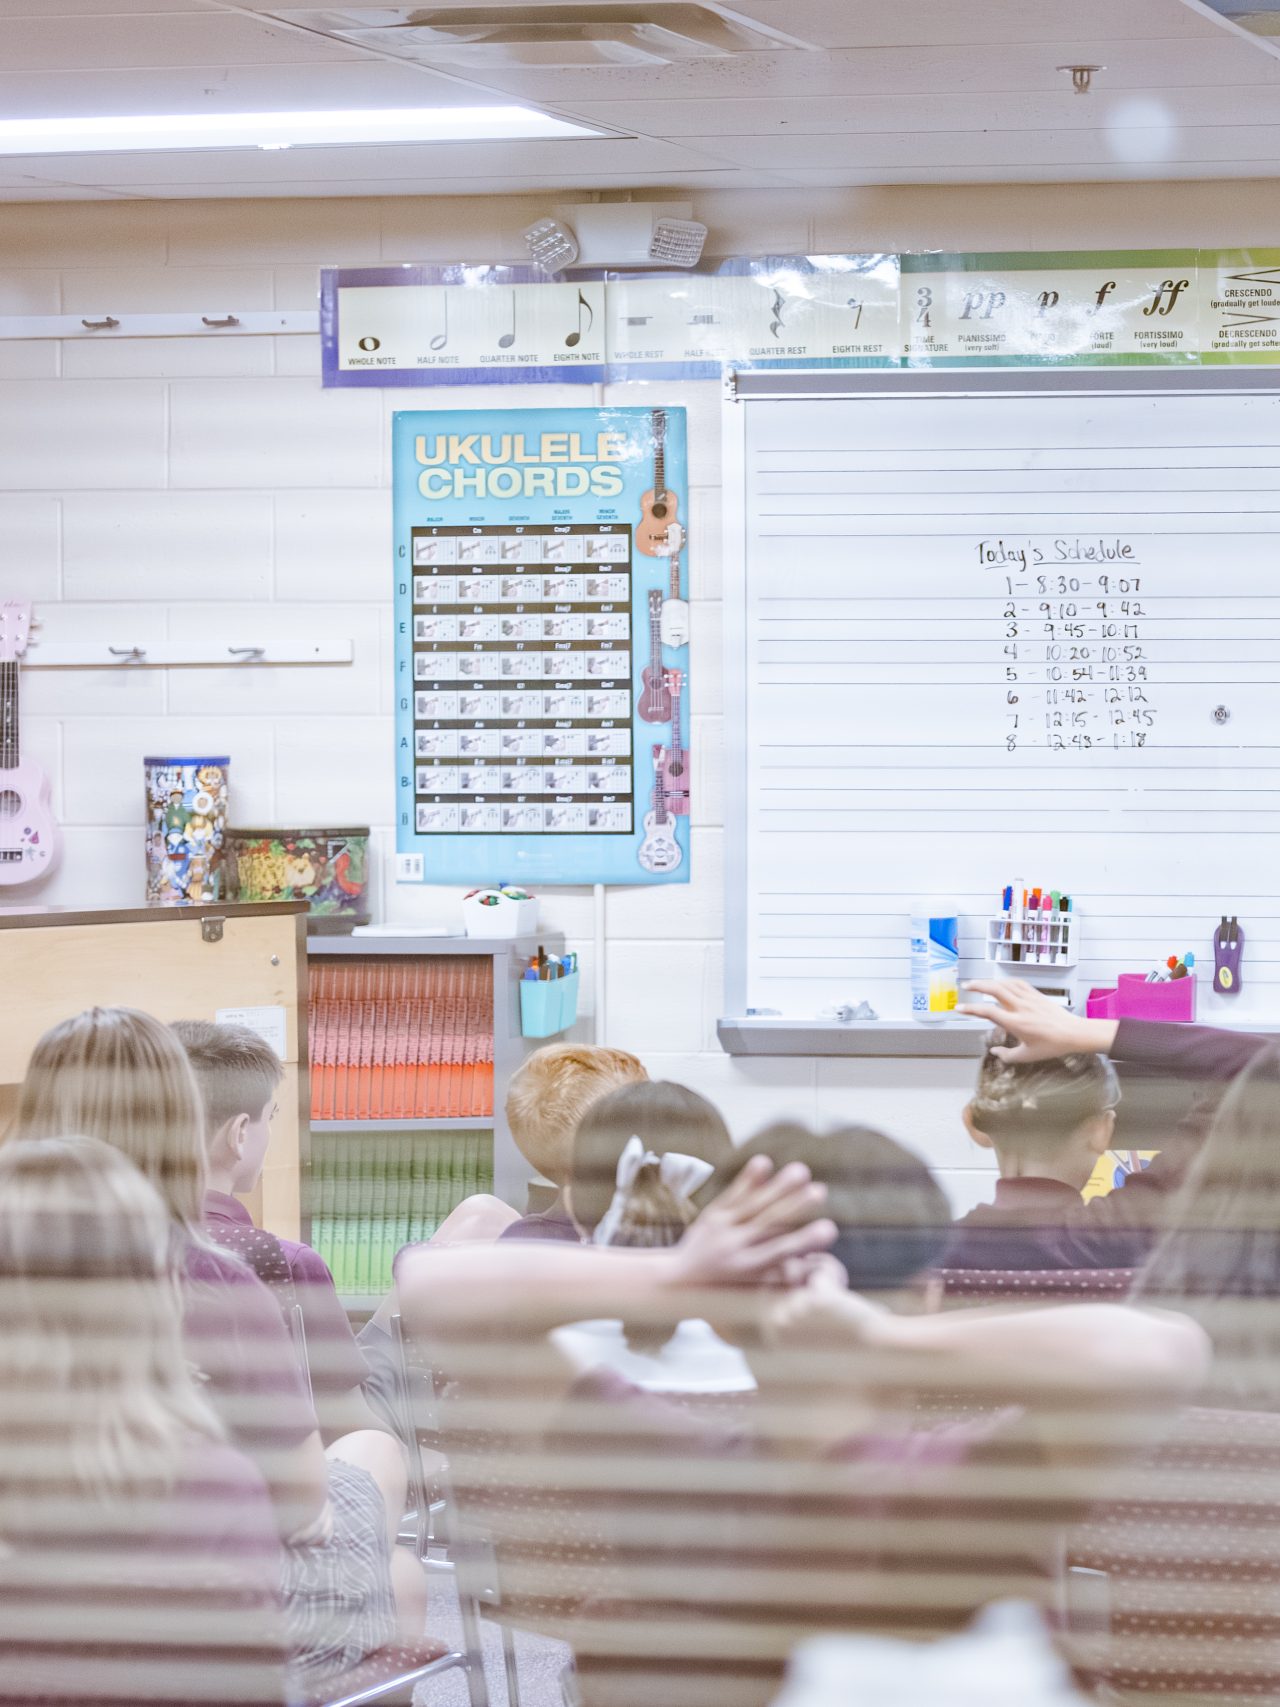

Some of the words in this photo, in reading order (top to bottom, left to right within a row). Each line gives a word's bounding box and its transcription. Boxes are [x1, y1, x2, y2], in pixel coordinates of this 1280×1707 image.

[1225, 289, 1272, 297] CRESCENDO
[1210, 299, 1247, 309] (gradually
[1248, 299, 1259, 309] get
[1134, 331, 1184, 340] FORTISSIMO
[1219, 329, 1277, 338] DECRESCENDO
[958, 334, 1006, 343] PIANISSIMO
[832, 345, 861, 354] EIGHTH
[863, 344, 883, 353] REST
[1140, 340, 1158, 349] (very
[1160, 340, 1178, 349] loud)
[1249, 340, 1260, 349] get
[750, 346, 785, 355] QUARTER
[788, 345, 806, 354] REST
[348, 357, 374, 365] WHOLE
[376, 357, 396, 365] NOTE
[417, 356, 436, 365] HALF
[438, 355, 459, 364] NOTE
[480, 355, 516, 363] QUARTER
[518, 354, 538, 362] NOTE
[553, 353, 580, 362] EIGHTH
[581, 352, 600, 361] NOTE
[414, 431, 627, 466] UKULELE
[417, 465, 624, 500] CHORDS
[975, 540, 1044, 572] Today's
[1053, 539, 1136, 564] Schedule
